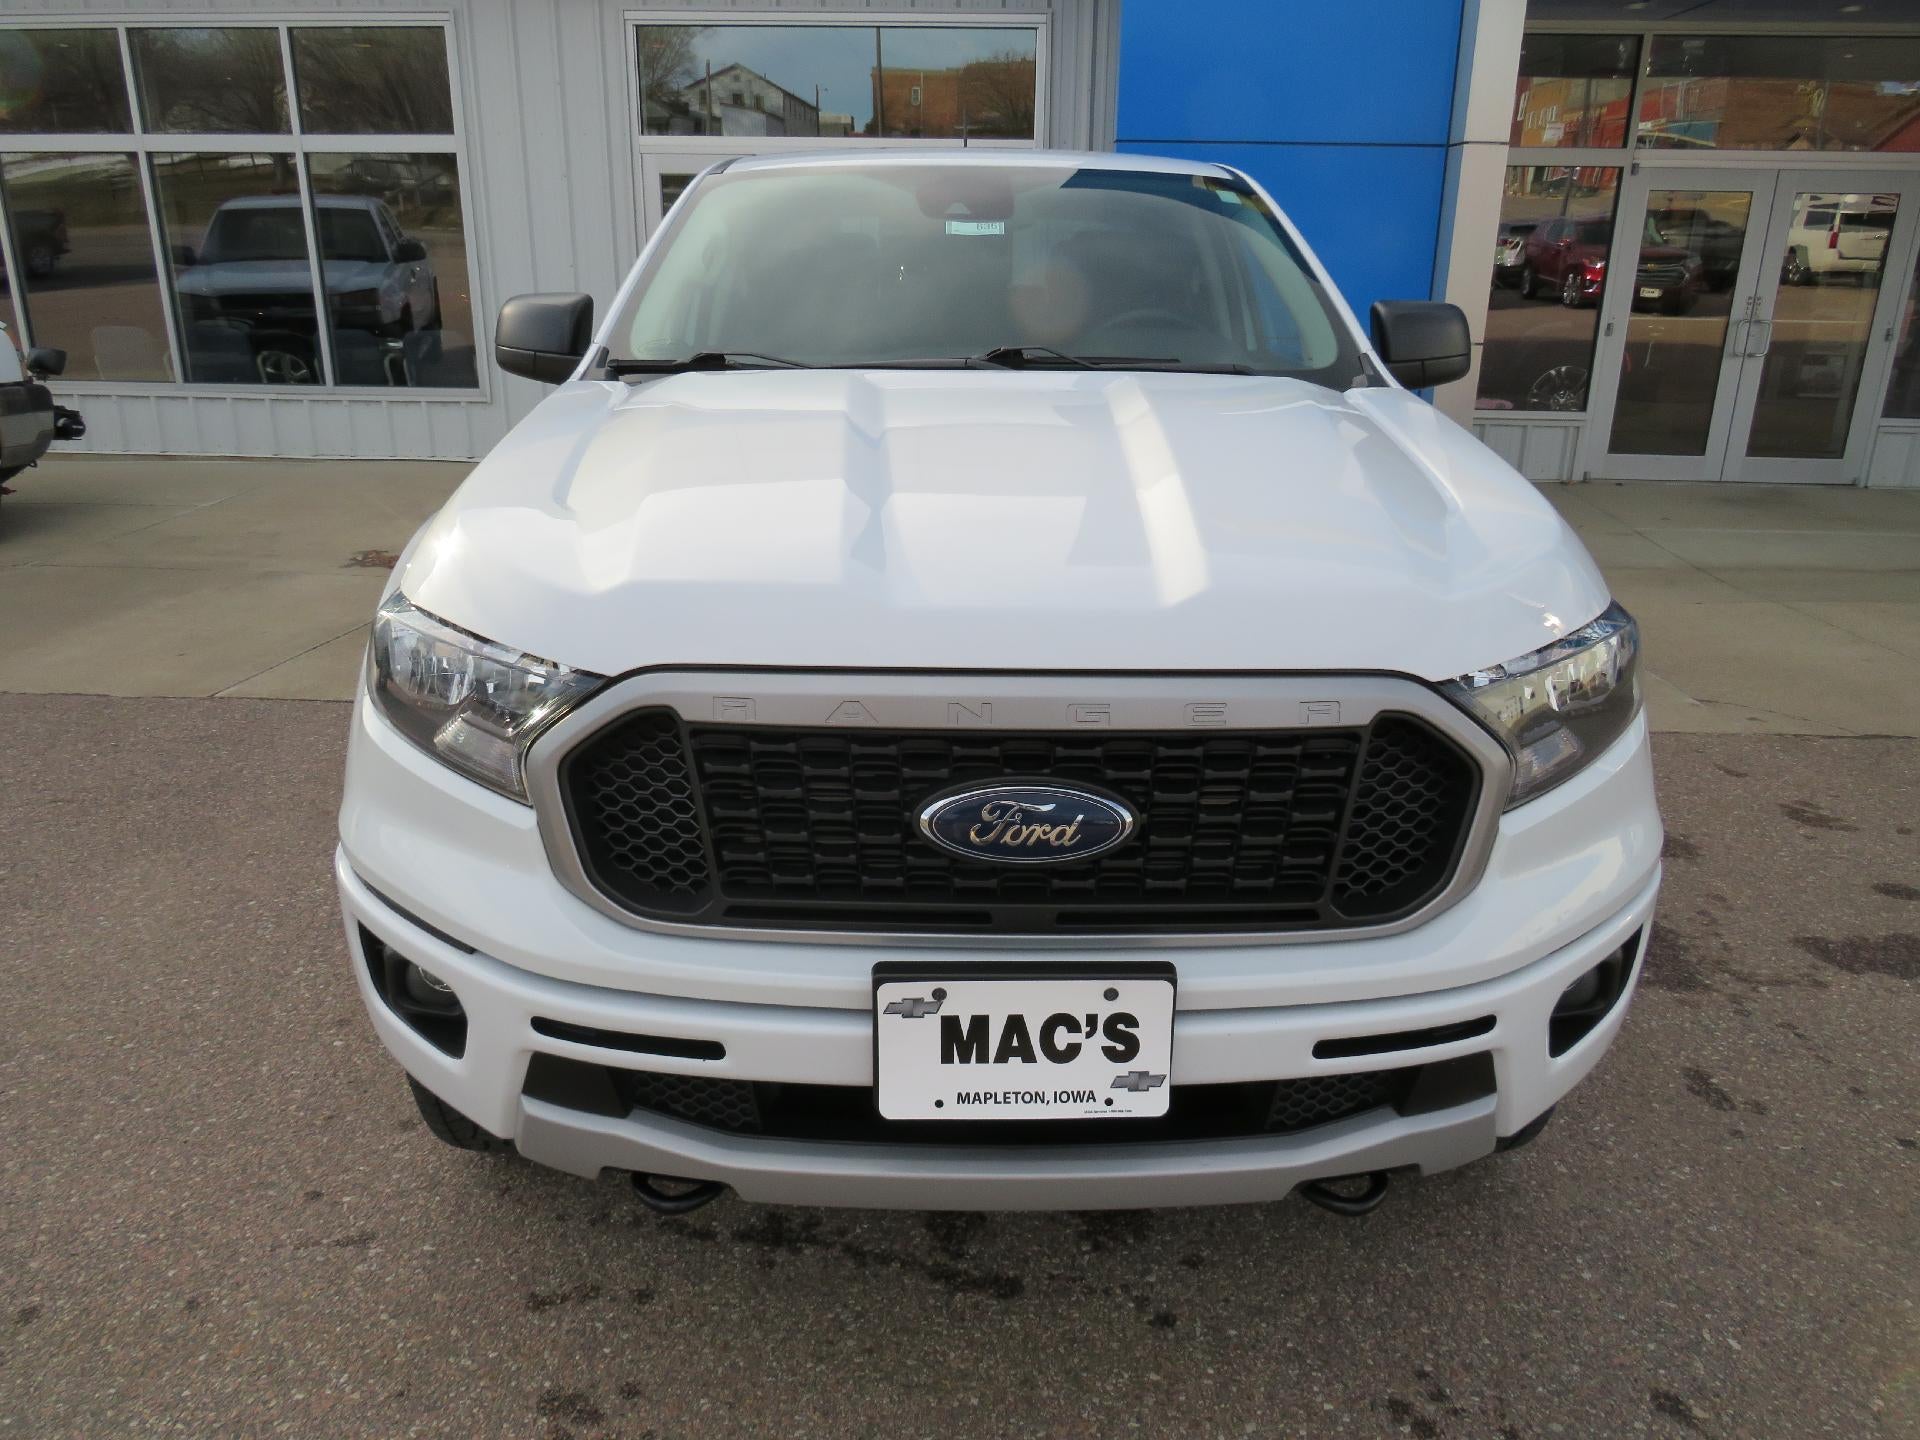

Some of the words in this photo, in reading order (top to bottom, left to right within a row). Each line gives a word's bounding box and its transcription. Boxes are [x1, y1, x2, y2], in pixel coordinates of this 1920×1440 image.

[712, 696, 1341, 726] RANGER
[969, 801, 1085, 847] Ford
[940, 1012, 1140, 1064] MAC'S
[956, 1091, 1050, 1106] MAPLETON,
[1053, 1089, 1097, 1104] IOWA
